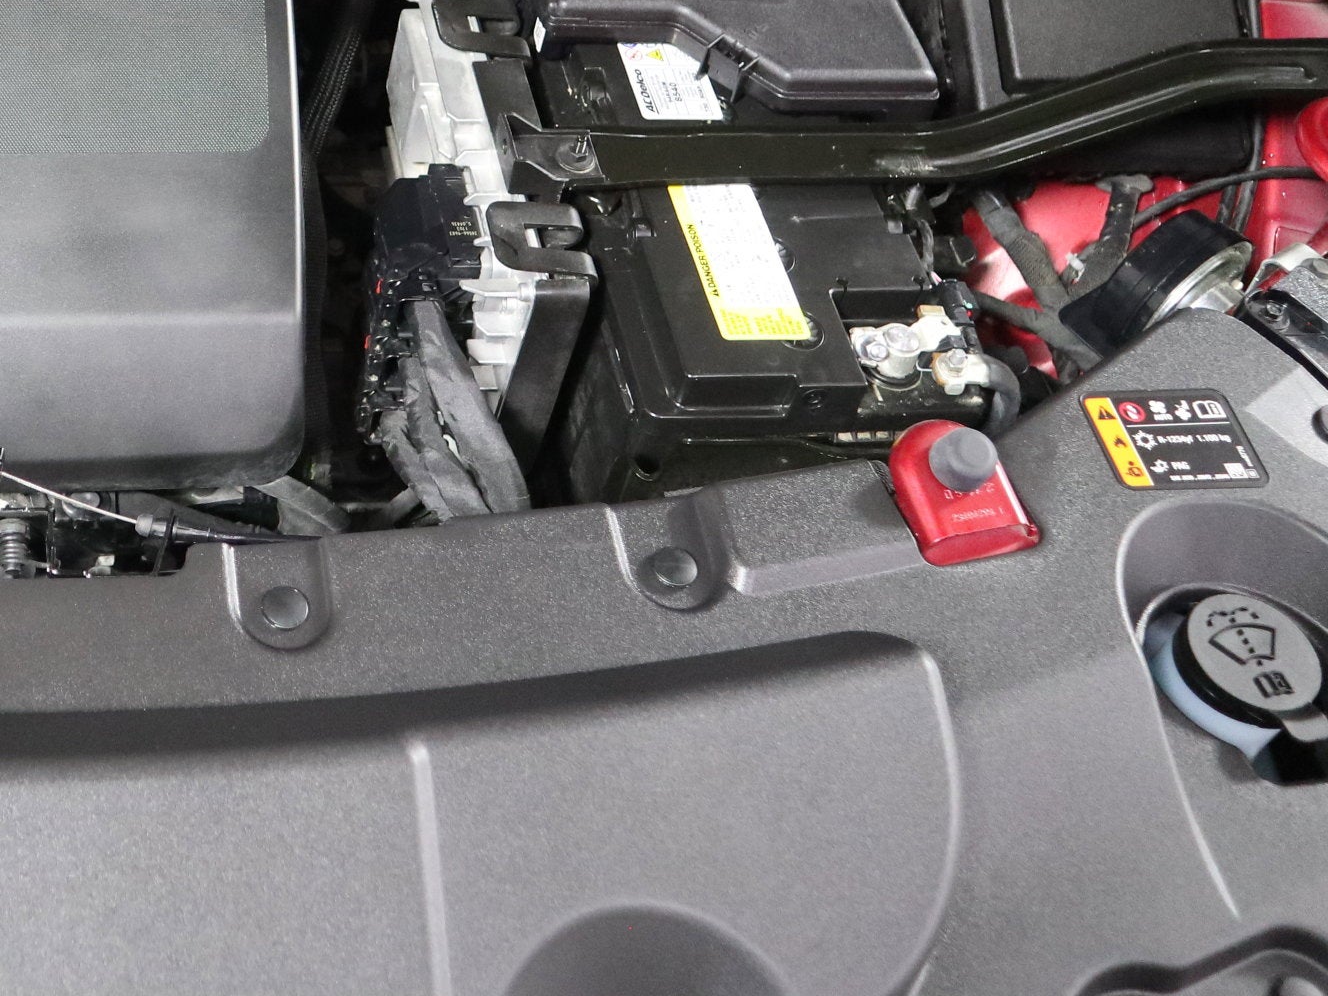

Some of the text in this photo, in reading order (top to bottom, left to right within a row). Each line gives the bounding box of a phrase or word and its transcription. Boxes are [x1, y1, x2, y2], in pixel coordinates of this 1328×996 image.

[633, 68, 656, 113] ACDelco
[686, 223, 718, 293] DANGER POISON
